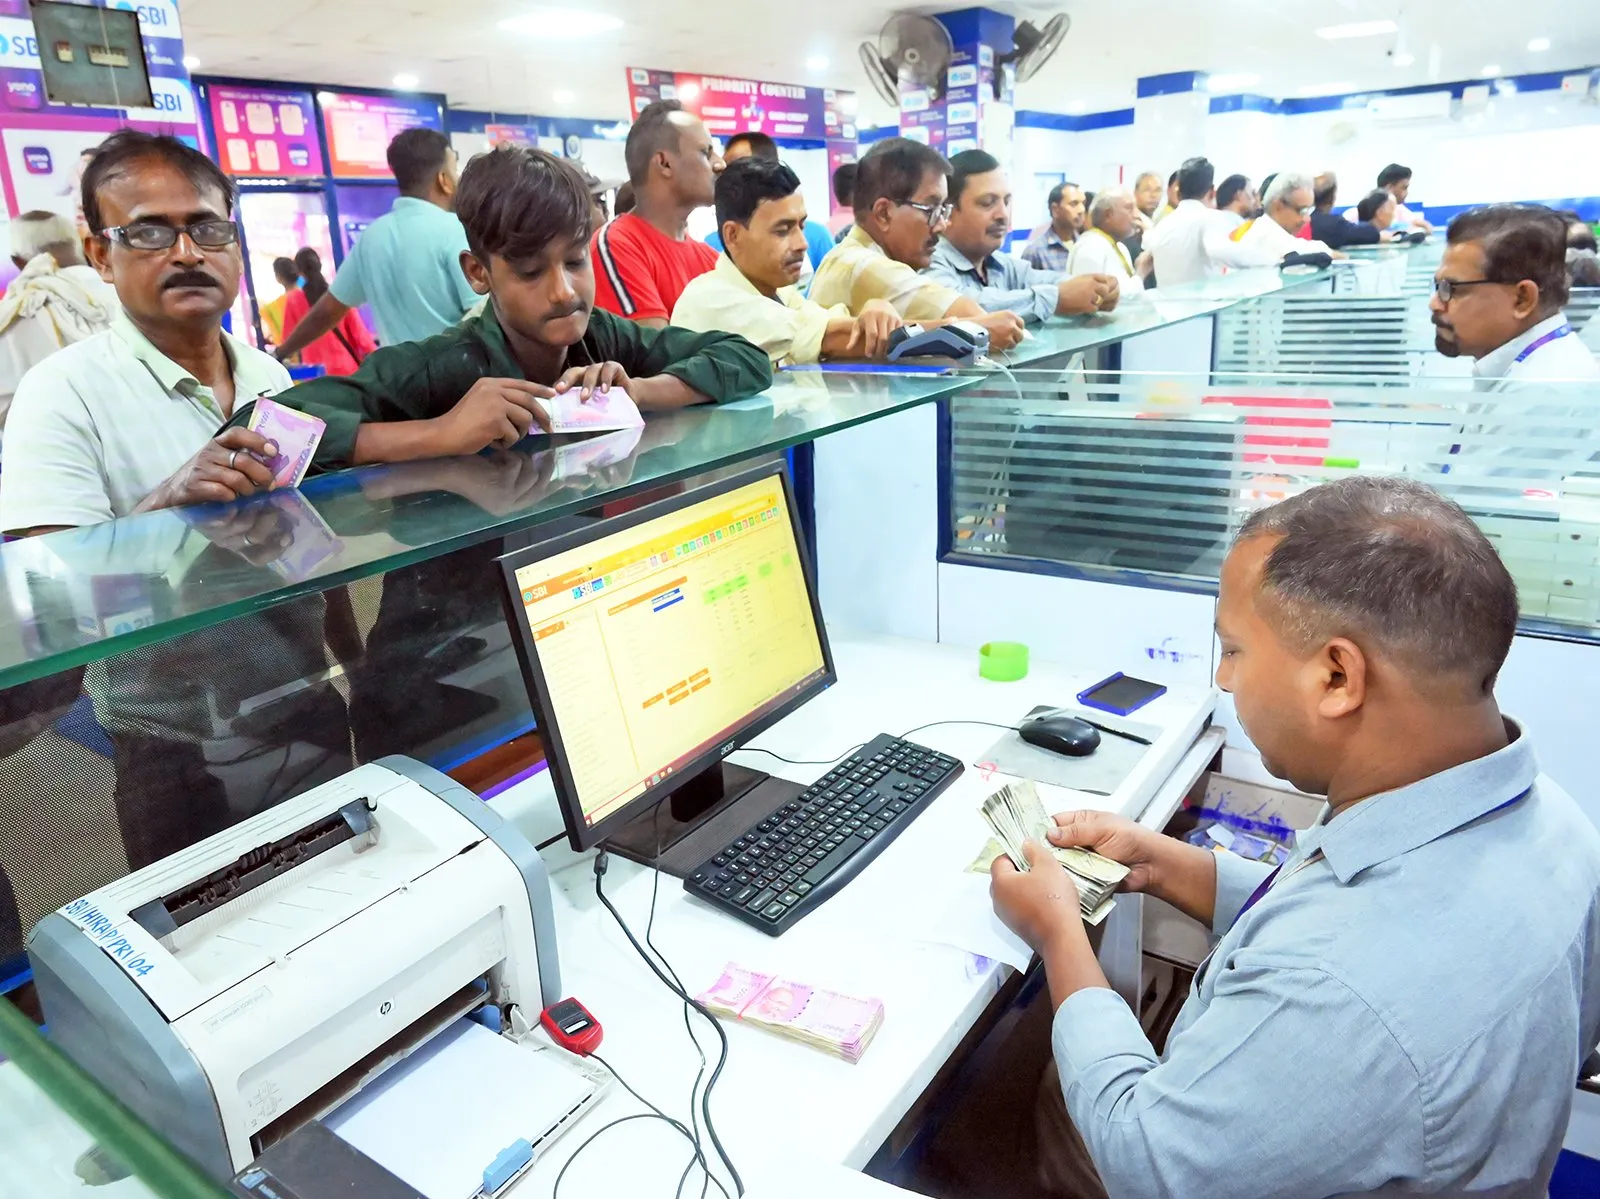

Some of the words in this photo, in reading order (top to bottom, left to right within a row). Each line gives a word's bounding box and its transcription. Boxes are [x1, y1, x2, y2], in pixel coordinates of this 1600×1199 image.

[137, 6, 167, 26] SBI
[12, 37, 39, 56] SB
[701, 77, 758, 95] PRIORITY
[760, 83, 806, 100] COUNTER
[153, 94, 182, 111] SBI
[533, 585, 548, 599] SBI
[720, 740, 736, 756] acer
